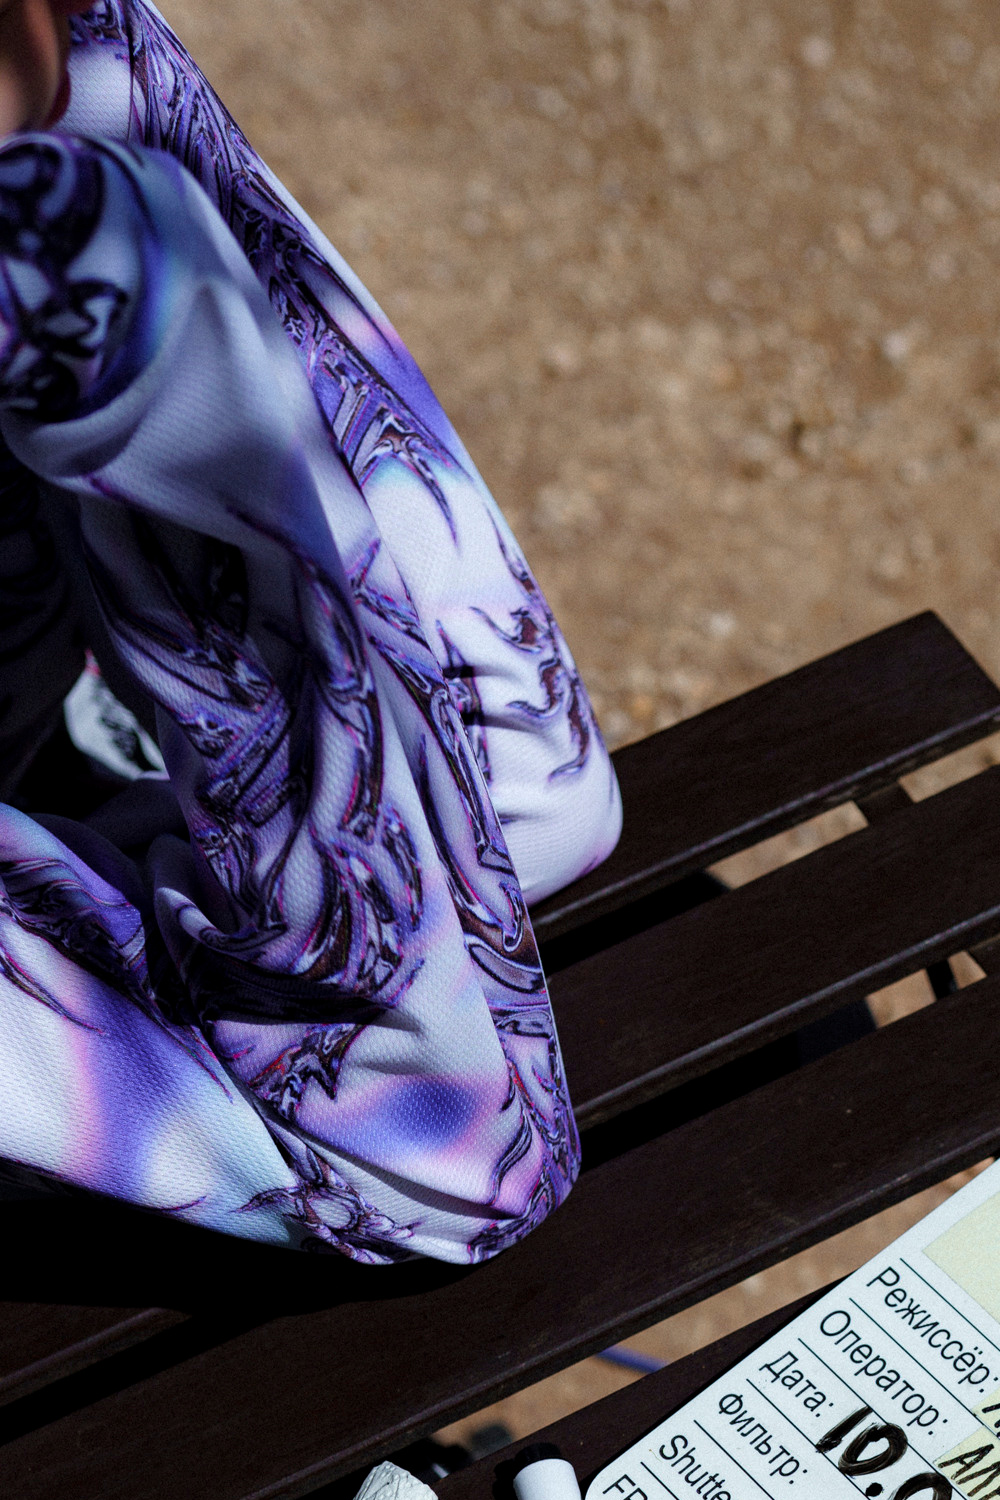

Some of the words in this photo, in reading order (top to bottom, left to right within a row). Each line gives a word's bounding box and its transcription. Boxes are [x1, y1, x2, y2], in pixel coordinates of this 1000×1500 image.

[760, 1350, 835, 1418] Дата:
[818, 1308, 949, 1436] Оператор:
[866, 1265, 1000, 1394] Режиссёр:
[717, 1392, 808, 1486] Фильтр:
